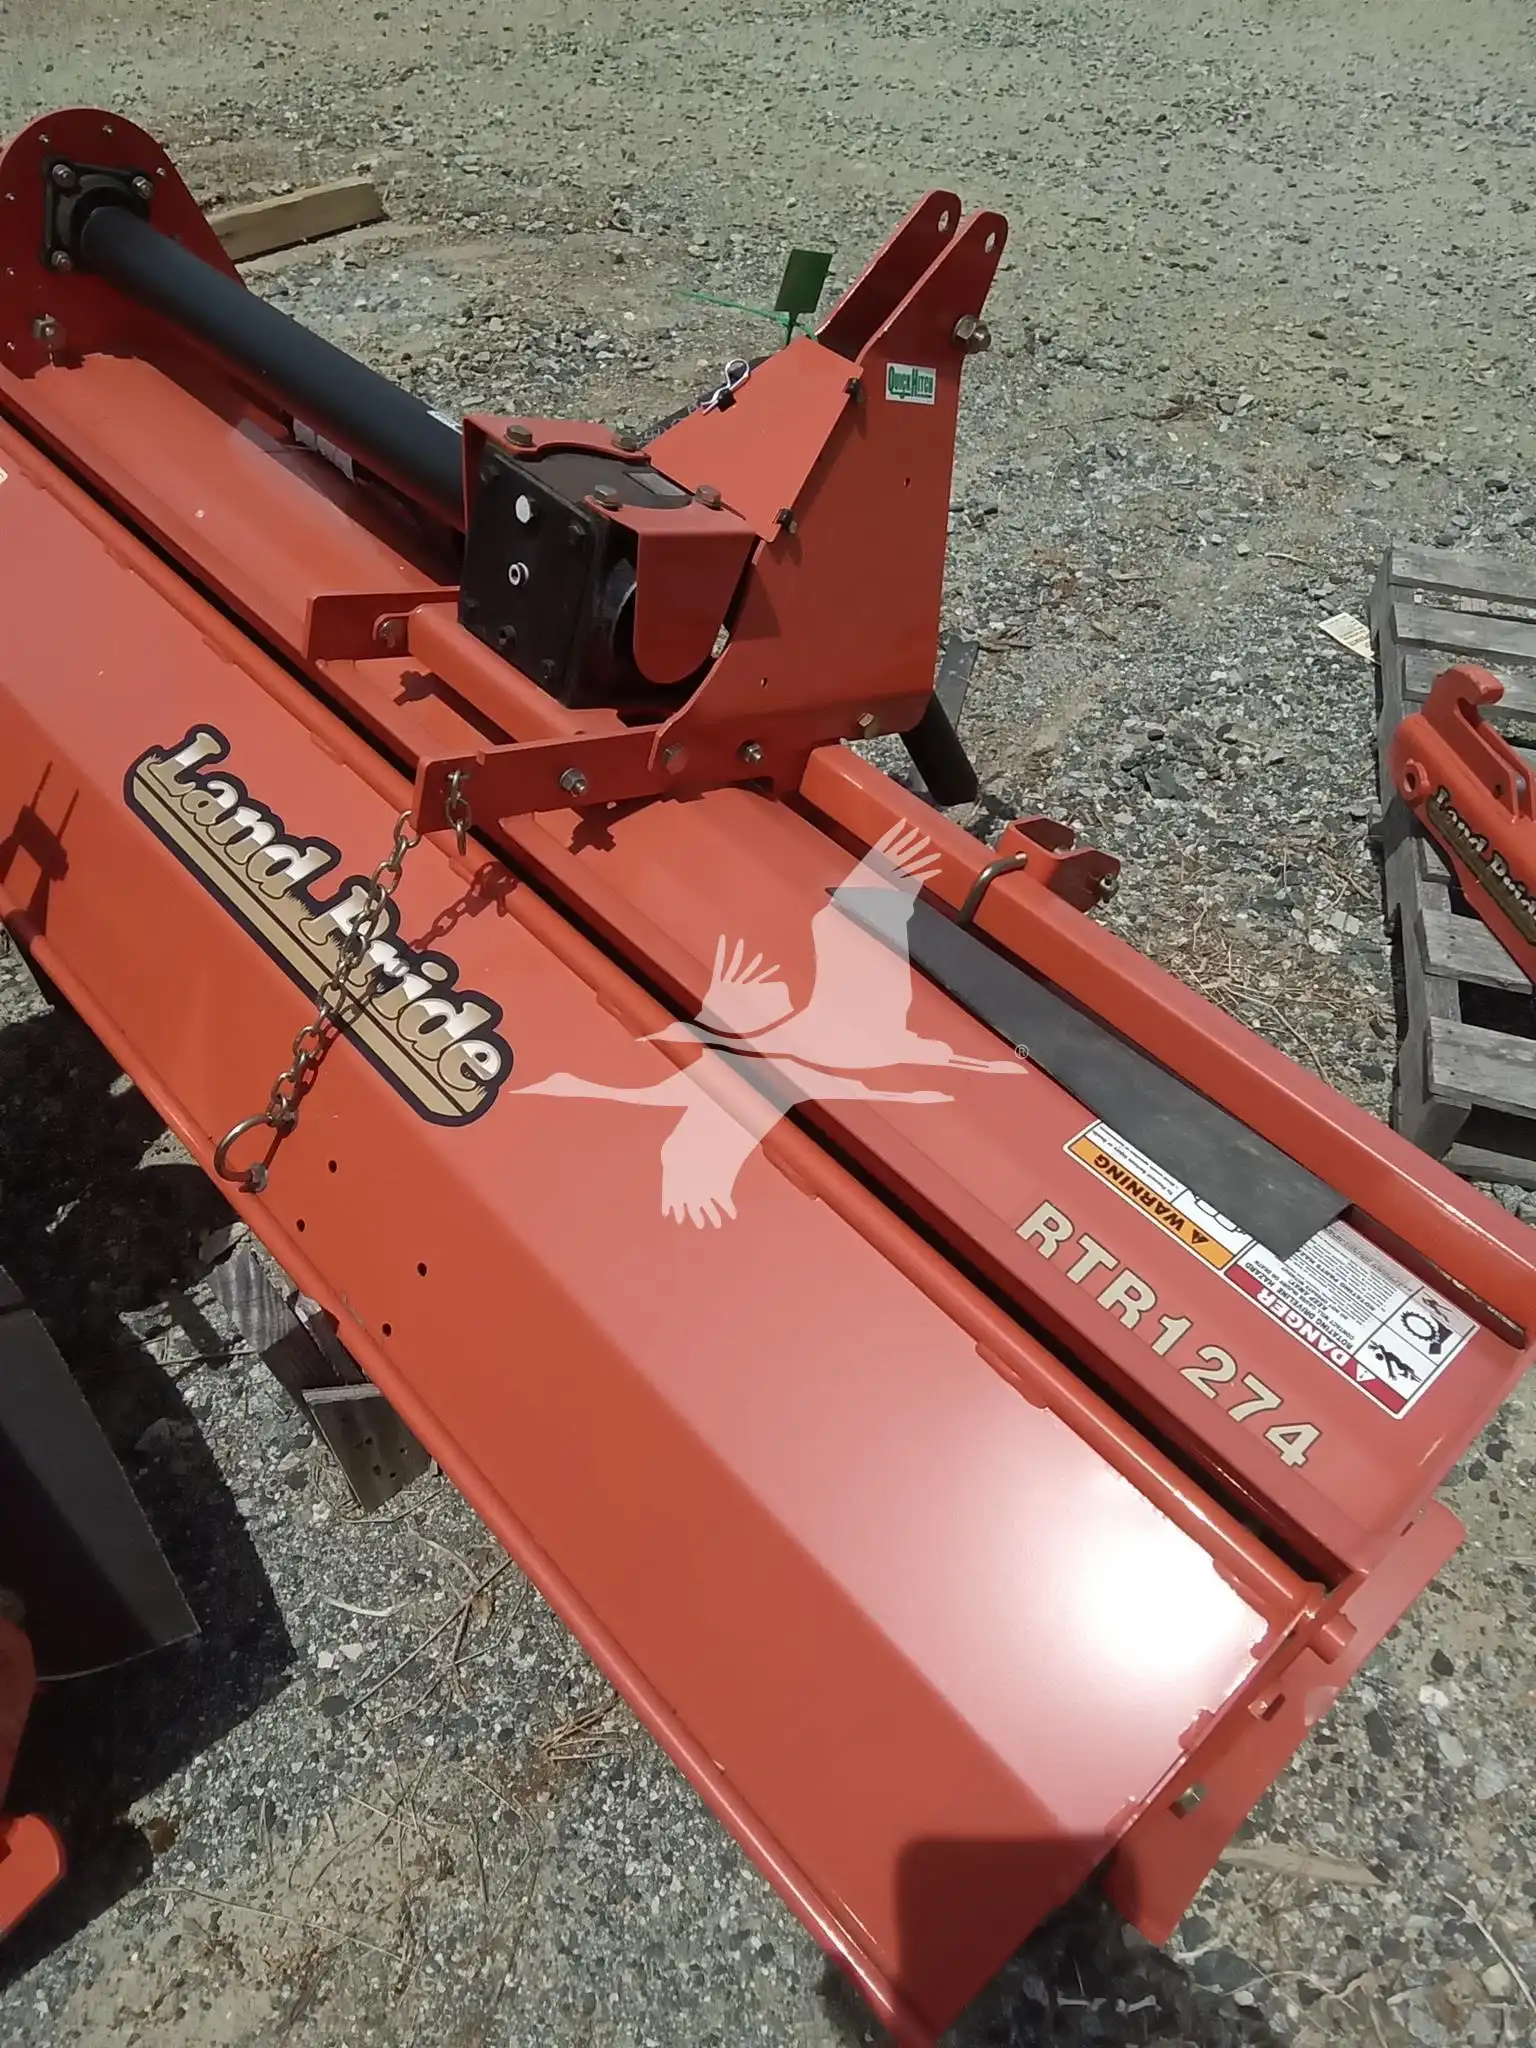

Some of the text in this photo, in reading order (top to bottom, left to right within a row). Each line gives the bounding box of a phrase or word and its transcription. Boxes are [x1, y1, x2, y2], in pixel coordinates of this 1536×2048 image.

[145, 730, 503, 1093] Land Pride
[1092, 1154, 1186, 1229] WARNING
[1242, 1261, 1275, 1287] HAZARD
[1255, 1287, 1350, 1367] DANGER
[1275, 1287, 1316, 1319] DRIVELINE
[1308, 1294, 1328, 1311] KEEP
[1016, 1200, 1322, 1468] RTR1274
[1313, 1317, 1353, 1350] ROTATING
